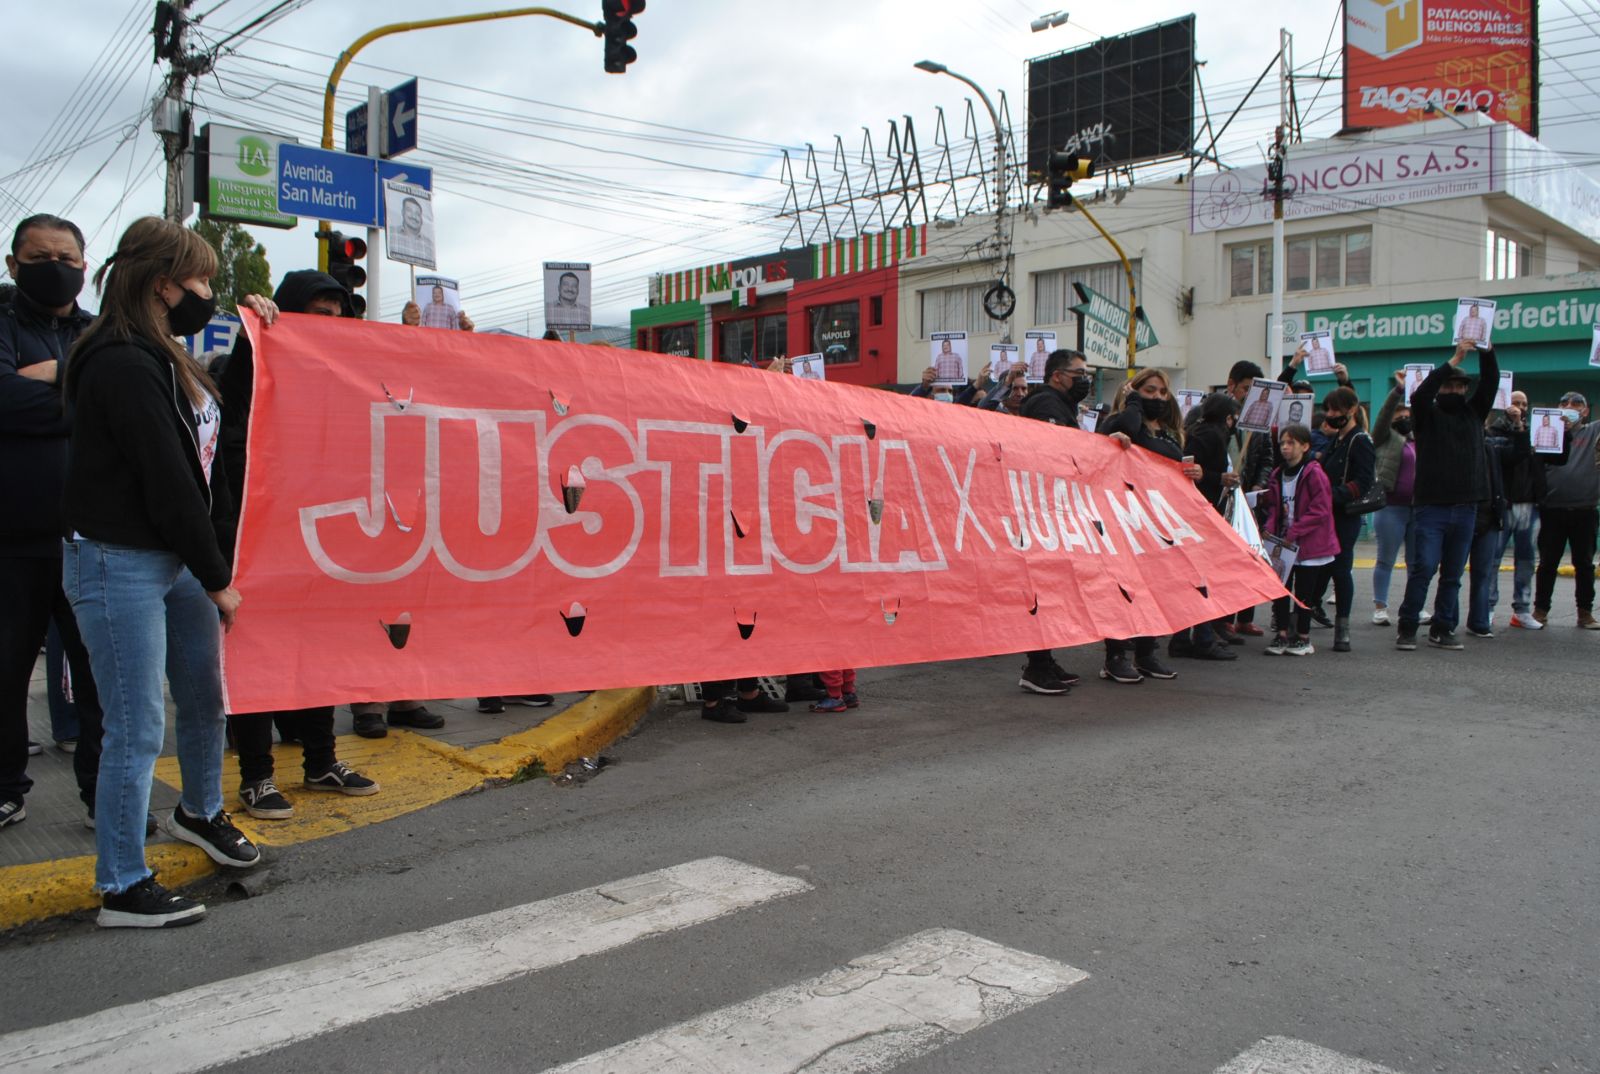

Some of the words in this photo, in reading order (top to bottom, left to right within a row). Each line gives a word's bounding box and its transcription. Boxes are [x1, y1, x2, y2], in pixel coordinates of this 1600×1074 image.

[1426, 8, 1502, 21] PATAGONIA
[1426, 21, 1481, 32] BUENOS
[1483, 22, 1523, 34] AIRES
[283, 159, 334, 185] Avenida
[1396, 144, 1480, 178] S.A.S.
[217, 192, 260, 208] Austral
[281, 182, 309, 204] San
[311, 186, 357, 211] Martín
[1313, 313, 1445, 340] Préstamos
[1493, 297, 1600, 331] efectiv
[299, 402, 949, 584] JUSTICIA
[1000, 469, 1118, 556] JUAN
[1104, 489, 1205, 556] MA
